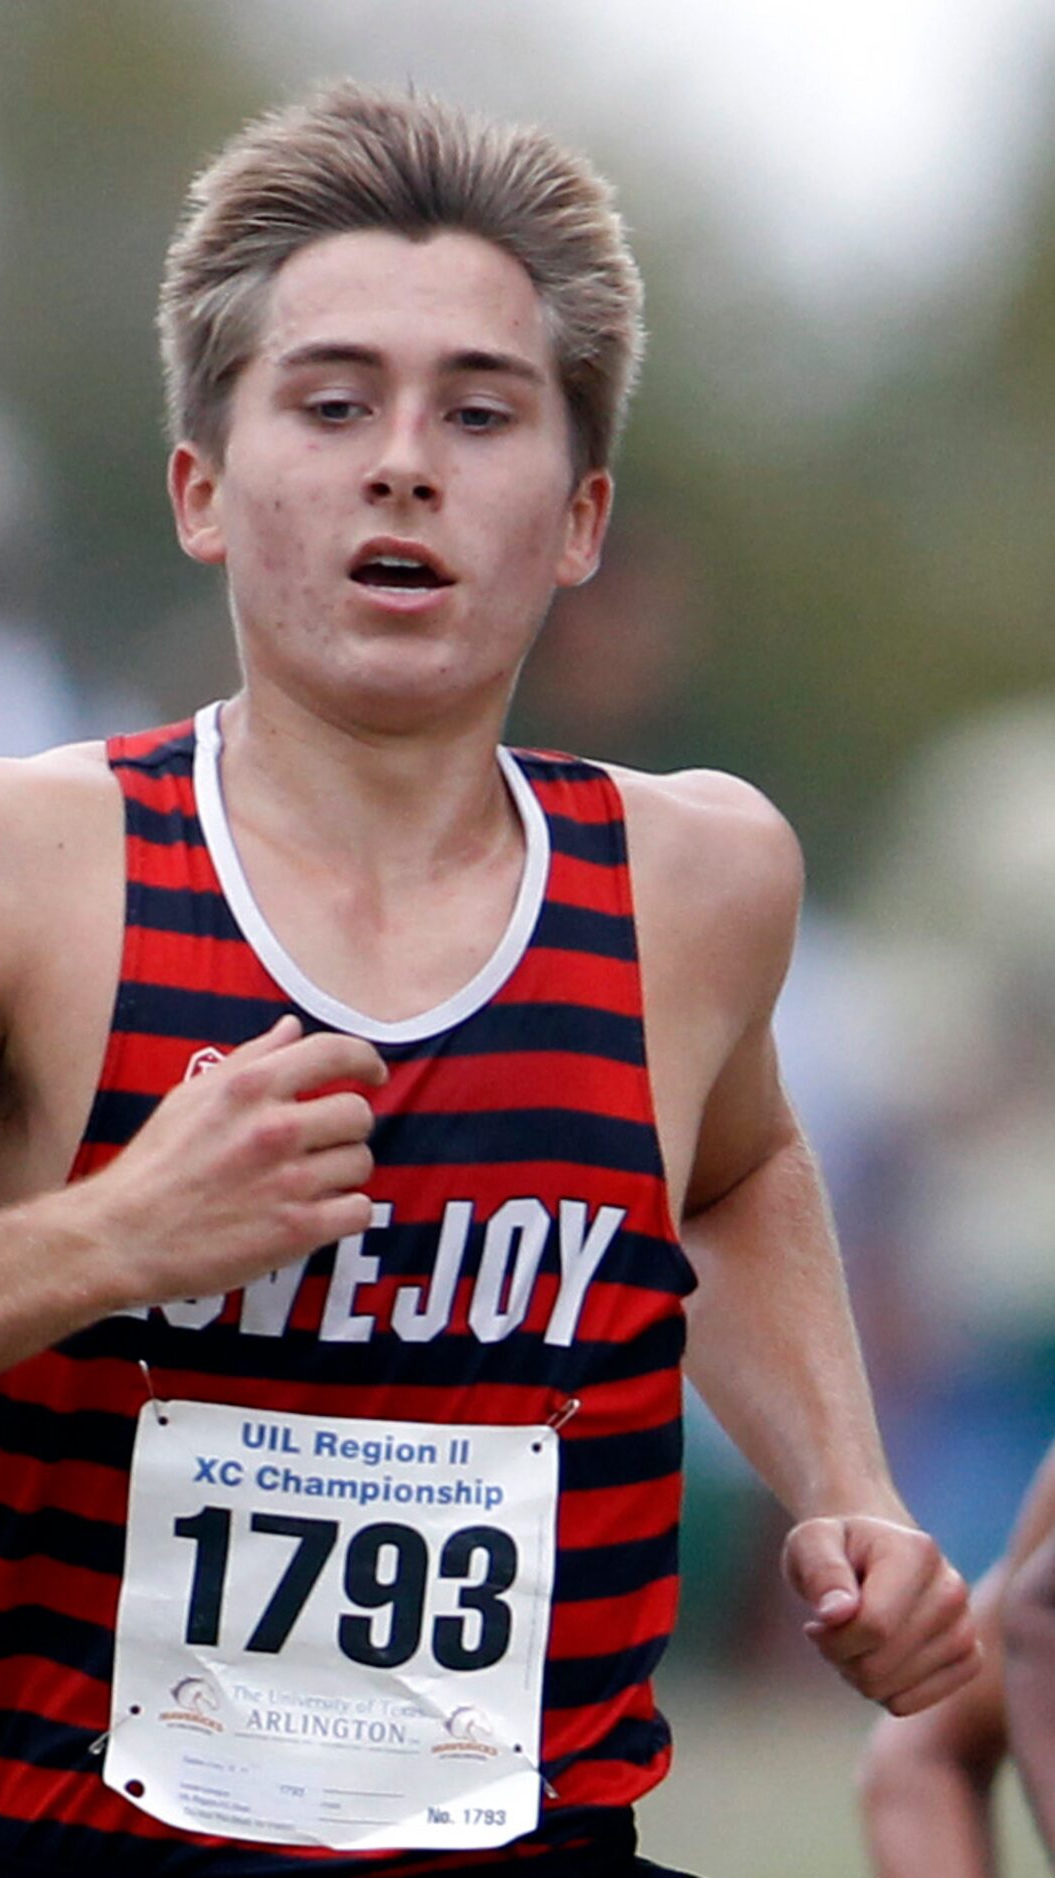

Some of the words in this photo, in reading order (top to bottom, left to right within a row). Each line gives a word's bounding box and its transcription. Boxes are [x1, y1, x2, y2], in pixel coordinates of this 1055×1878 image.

[242, 1423, 301, 1455] UIL
[314, 1431, 437, 1466] Region
[448, 1440, 469, 1465] II
[193, 1457, 246, 1487] XC
[256, 1465, 505, 1509] Championship
[174, 1505, 518, 1673] 1793
[233, 1685, 263, 1703] The
[269, 1689, 348, 1713] University
[356, 1697, 373, 1713] of
[246, 1709, 406, 1744] ARLINGTON
[427, 1807, 455, 1825] No.
